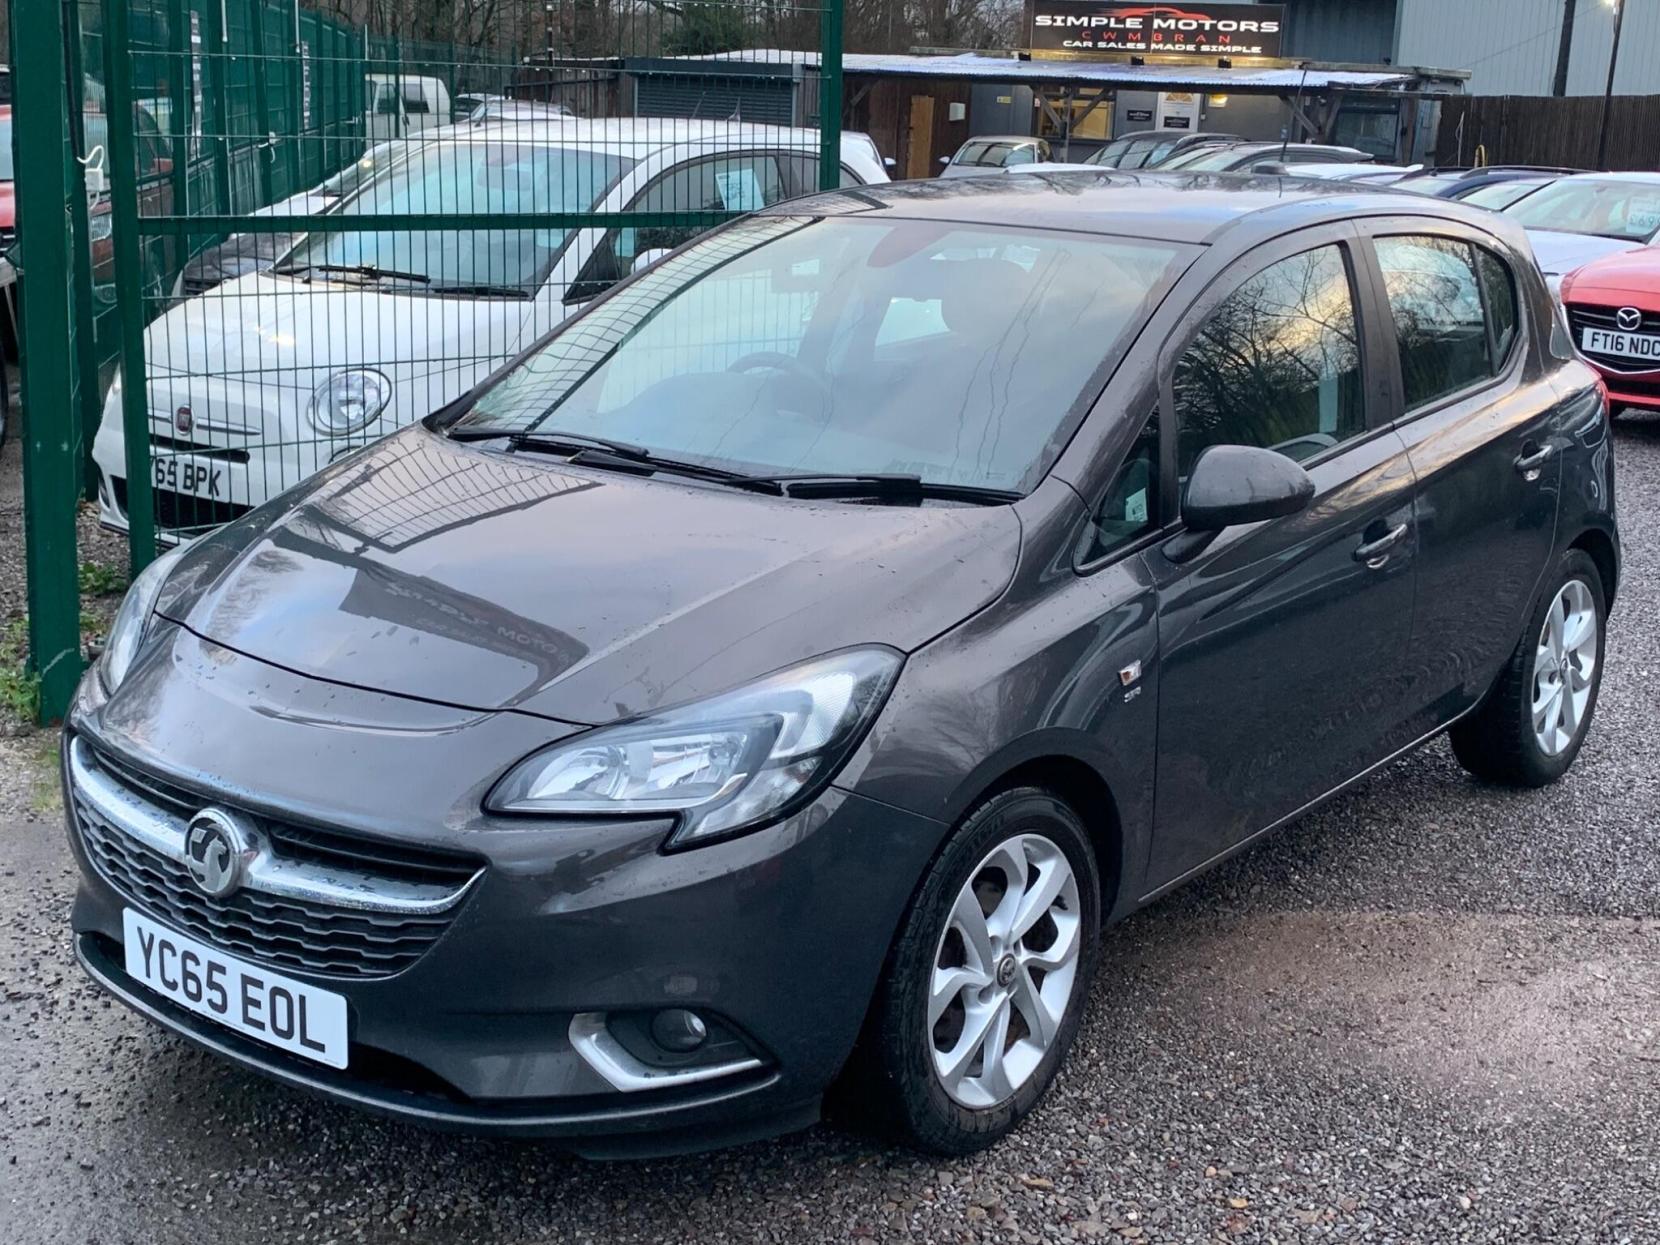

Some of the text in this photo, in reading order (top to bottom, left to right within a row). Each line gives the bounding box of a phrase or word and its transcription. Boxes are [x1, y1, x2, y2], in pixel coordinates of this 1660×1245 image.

[1035, 15, 1280, 33] SIMPLE MOTORS
[1062, 40, 1262, 54] CAR SALES MADE SIMPLE
[1082, 31, 1231, 44] CWMBRAN
[1591, 331, 1625, 352] FT16
[183, 463, 222, 497] BPK
[137, 926, 326, 1054] YC65 EOL
